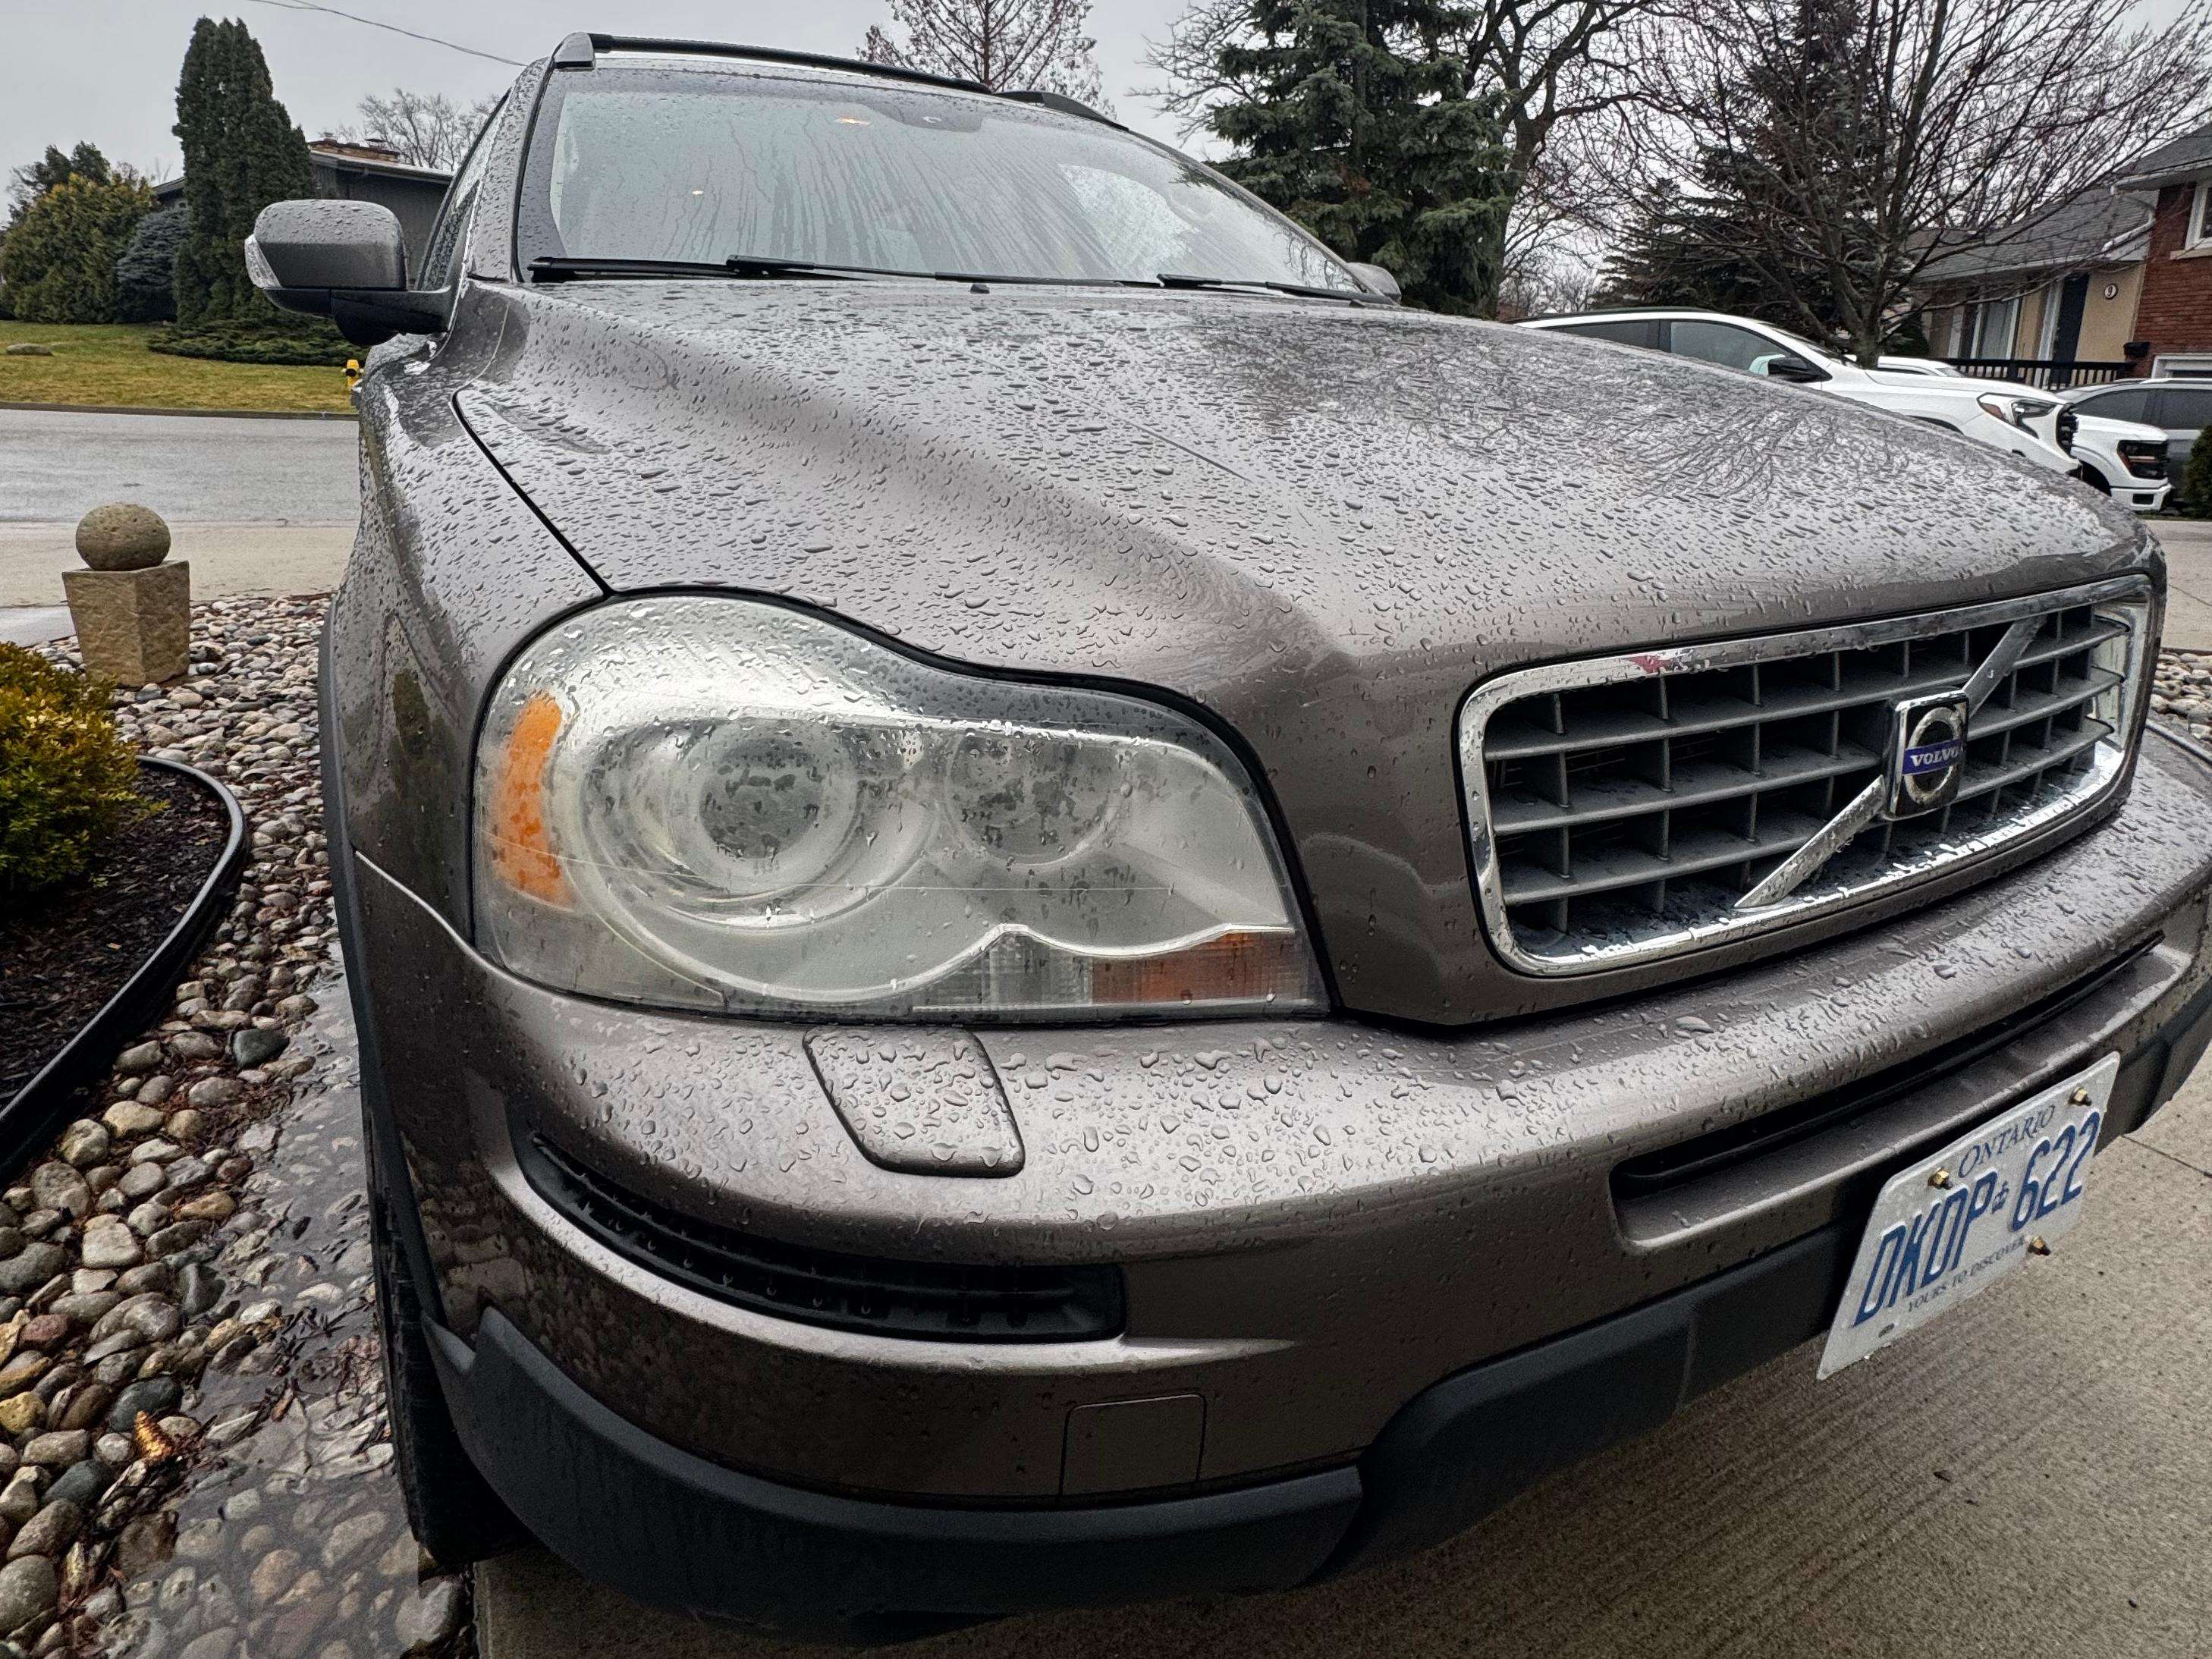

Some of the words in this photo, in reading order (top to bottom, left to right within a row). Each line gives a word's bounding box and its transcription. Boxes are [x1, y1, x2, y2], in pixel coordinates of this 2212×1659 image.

[1910, 746, 1959, 768] VOLVO
[1959, 1104, 2055, 1178] ONTARIO
[1853, 1170, 1998, 1328] DKDP
[2012, 1111, 2100, 1232] 622
[1908, 1286, 1946, 1312] YOURS
[1952, 1270, 1967, 1287] TO
